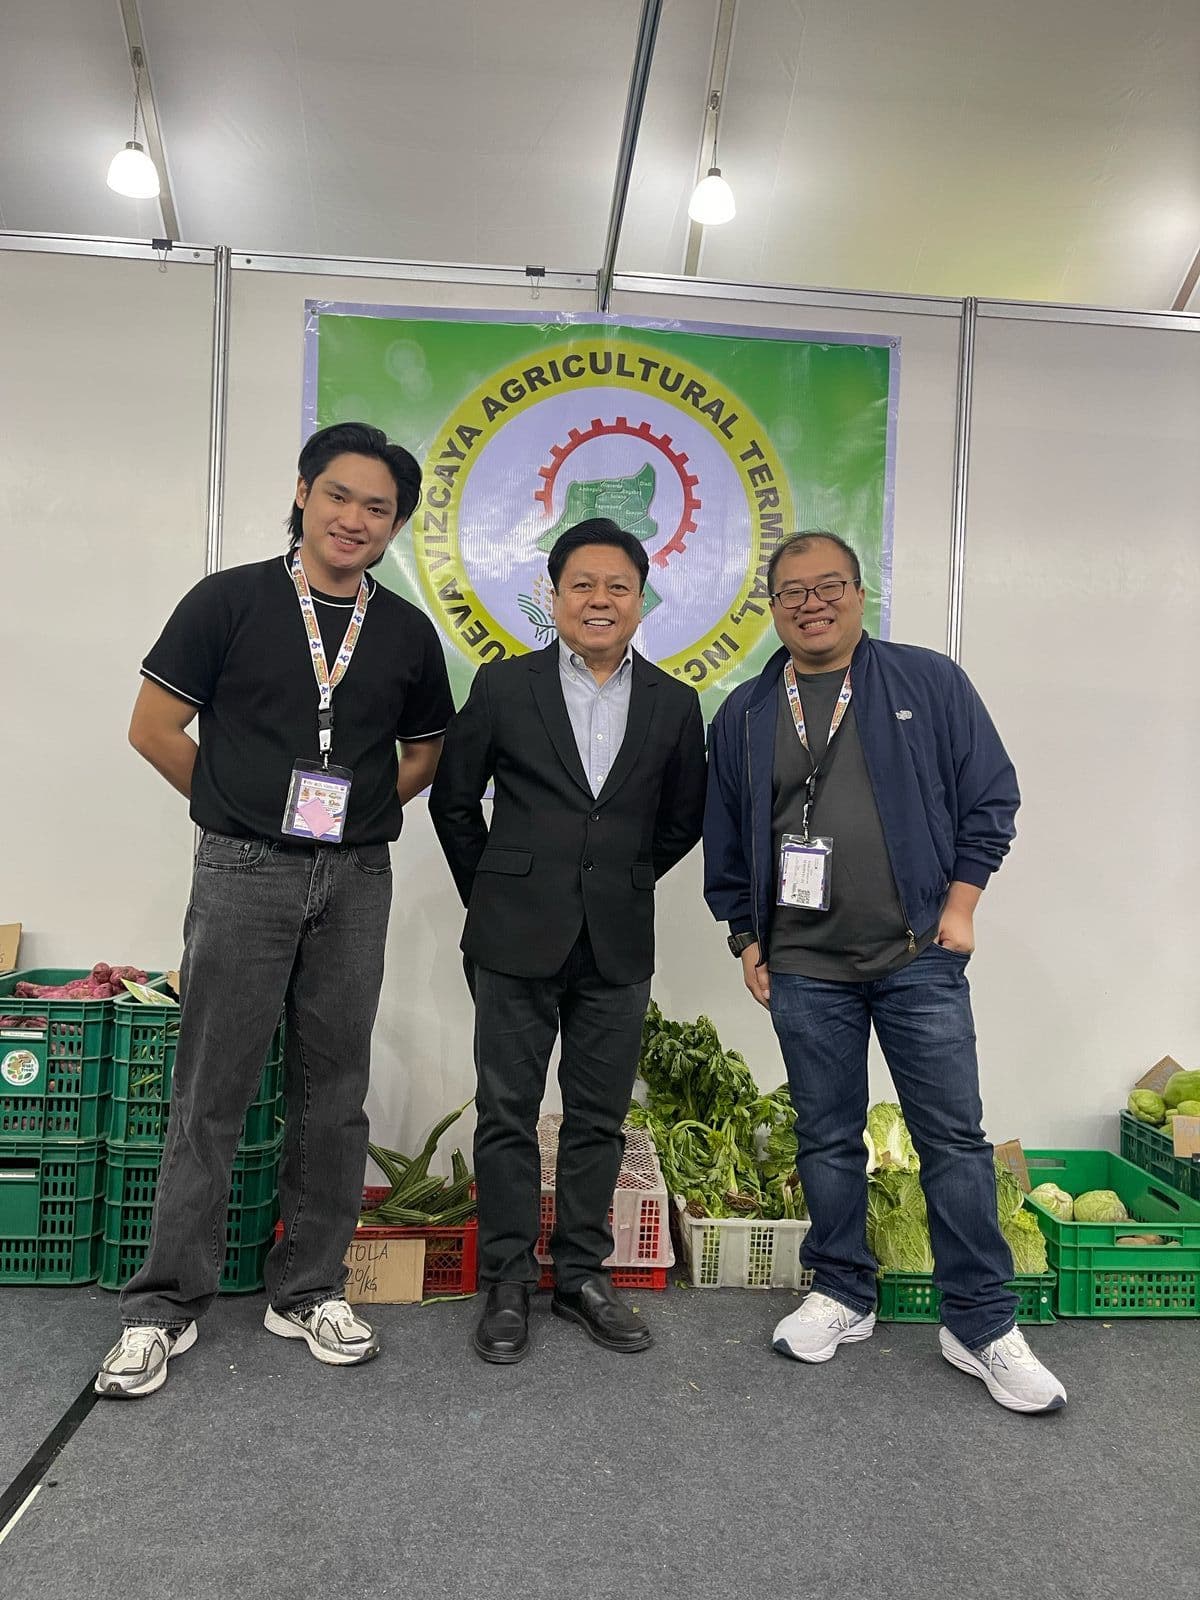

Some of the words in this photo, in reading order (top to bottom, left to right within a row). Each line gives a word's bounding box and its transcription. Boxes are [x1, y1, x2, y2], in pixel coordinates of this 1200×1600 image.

[481, 352, 738, 440] AGRICULTURAL
[423, 424, 483, 573] VIZCAYA
[438, 578, 505, 662] UEVA
[672, 632, 741, 683] INC.
